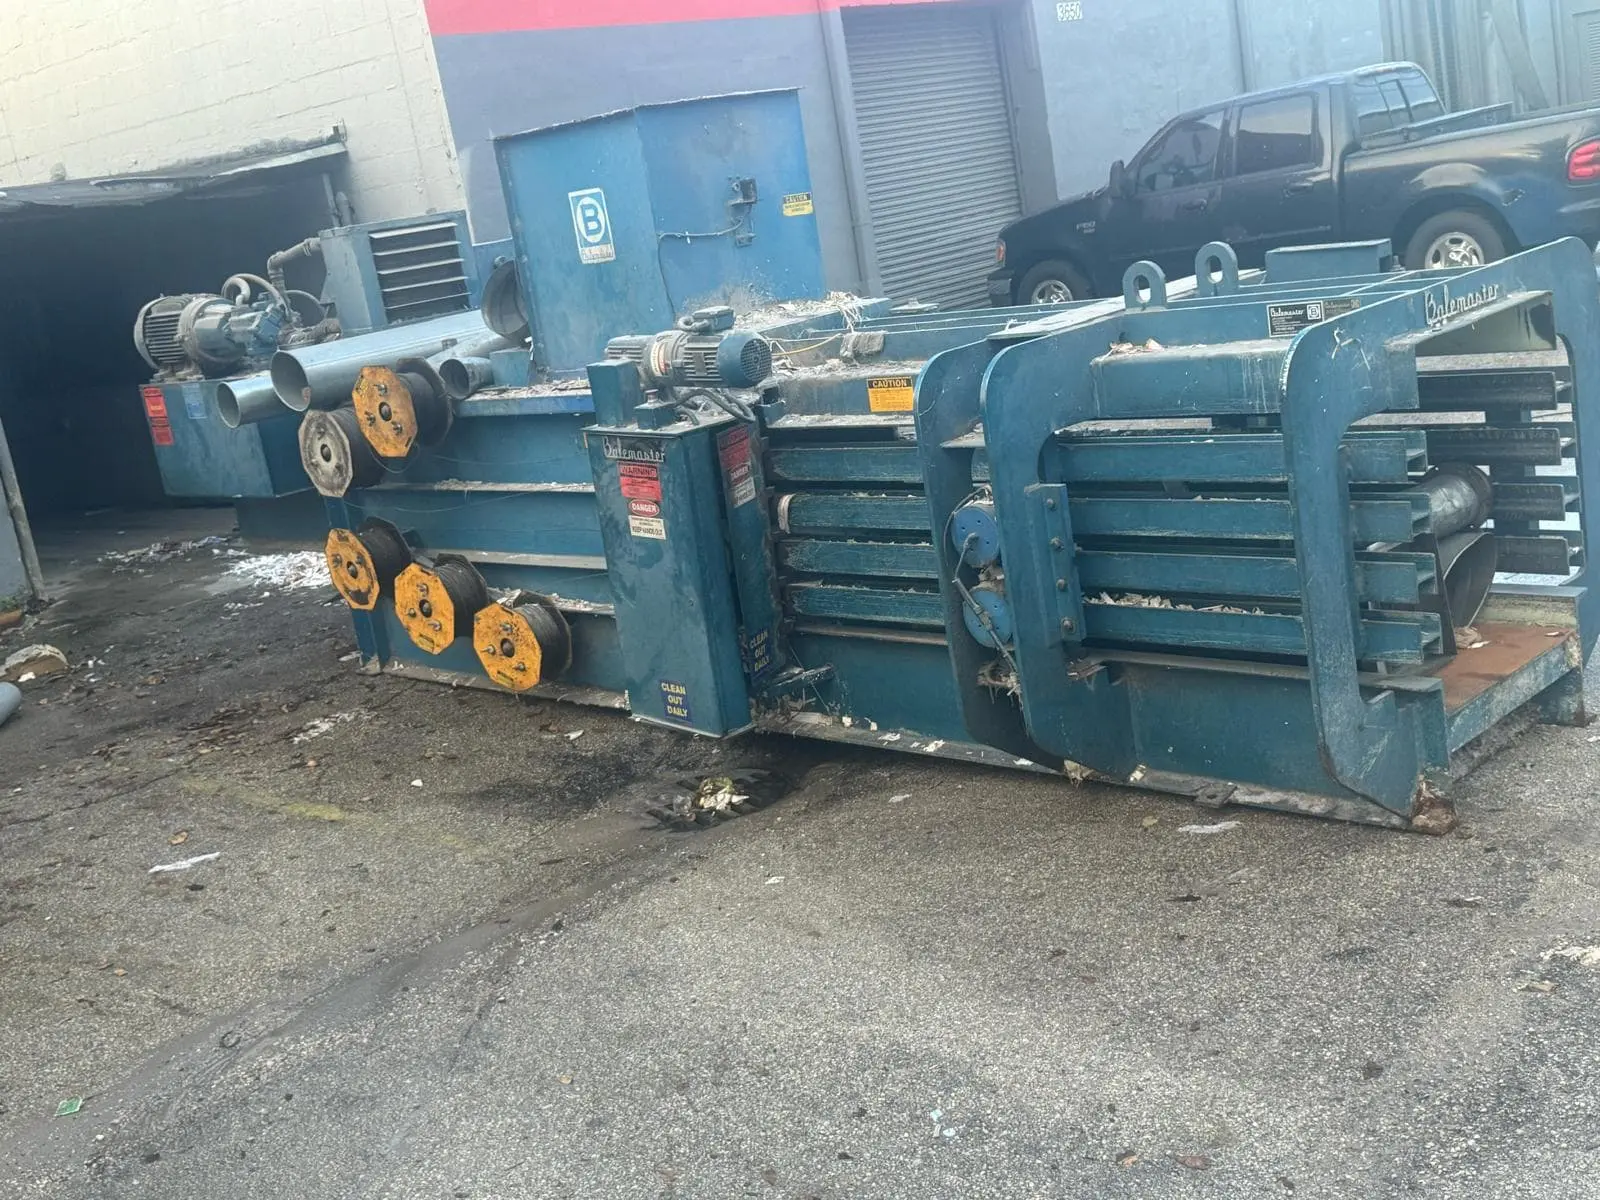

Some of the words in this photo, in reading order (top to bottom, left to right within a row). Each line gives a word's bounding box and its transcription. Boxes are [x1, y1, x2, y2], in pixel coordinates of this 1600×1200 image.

[1425, 284, 1499, 326] Balemaster
[872, 379, 907, 388] CAUTION
[602, 435, 665, 462] Balemaster
[631, 502, 657, 513] DANGER
[749, 631, 768, 649] CLEAN
[754, 645, 766, 658] OUT
[661, 682, 686, 695] CLEAN
[668, 695, 683, 705] OUT
[667, 706, 688, 717] DAILY
